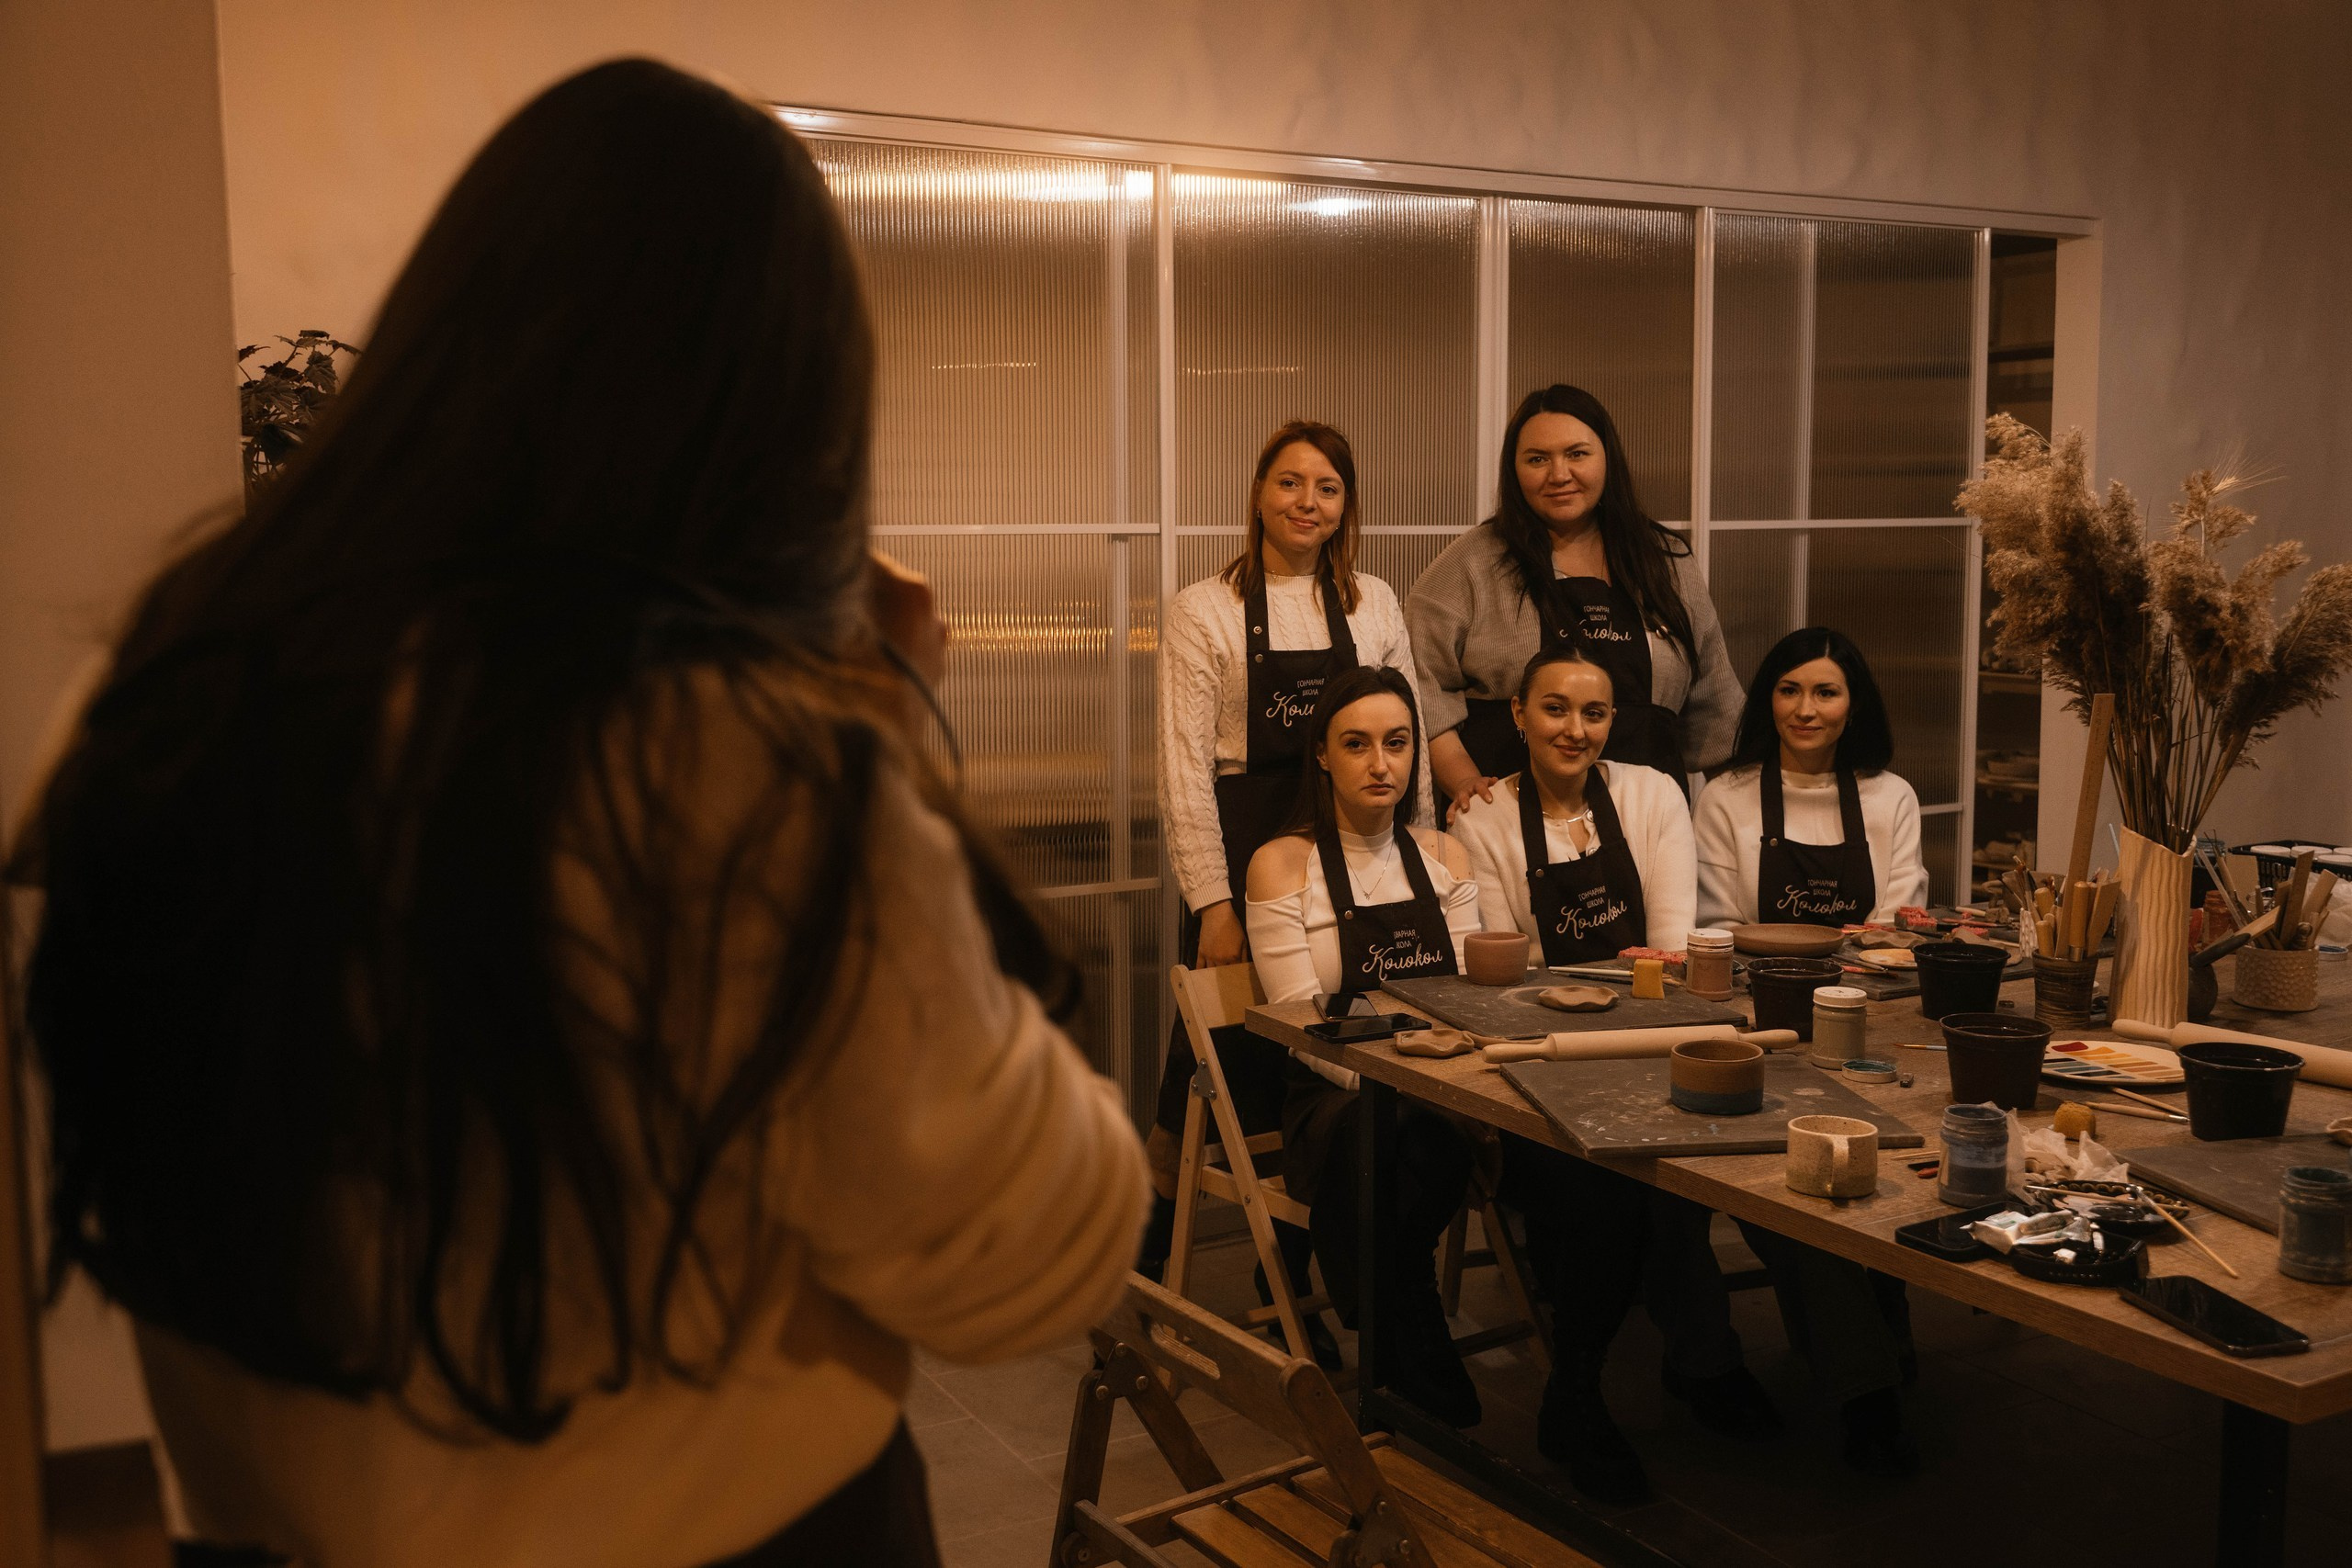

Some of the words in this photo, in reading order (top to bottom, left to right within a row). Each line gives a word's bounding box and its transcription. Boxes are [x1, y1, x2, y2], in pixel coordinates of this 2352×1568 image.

[1807, 879, 1838, 888] ГОНЧАРНАЯ
[1577, 885, 1606, 901] ГОНЧАРНАЯ
[1586, 897, 1605, 908] ШКОЛА
[1777, 885, 1857, 918] Колокол
[1556, 898, 1628, 940] Колокол
[1396, 940, 1412, 949] КОЛА
[1362, 942, 1442, 981] Колокол
